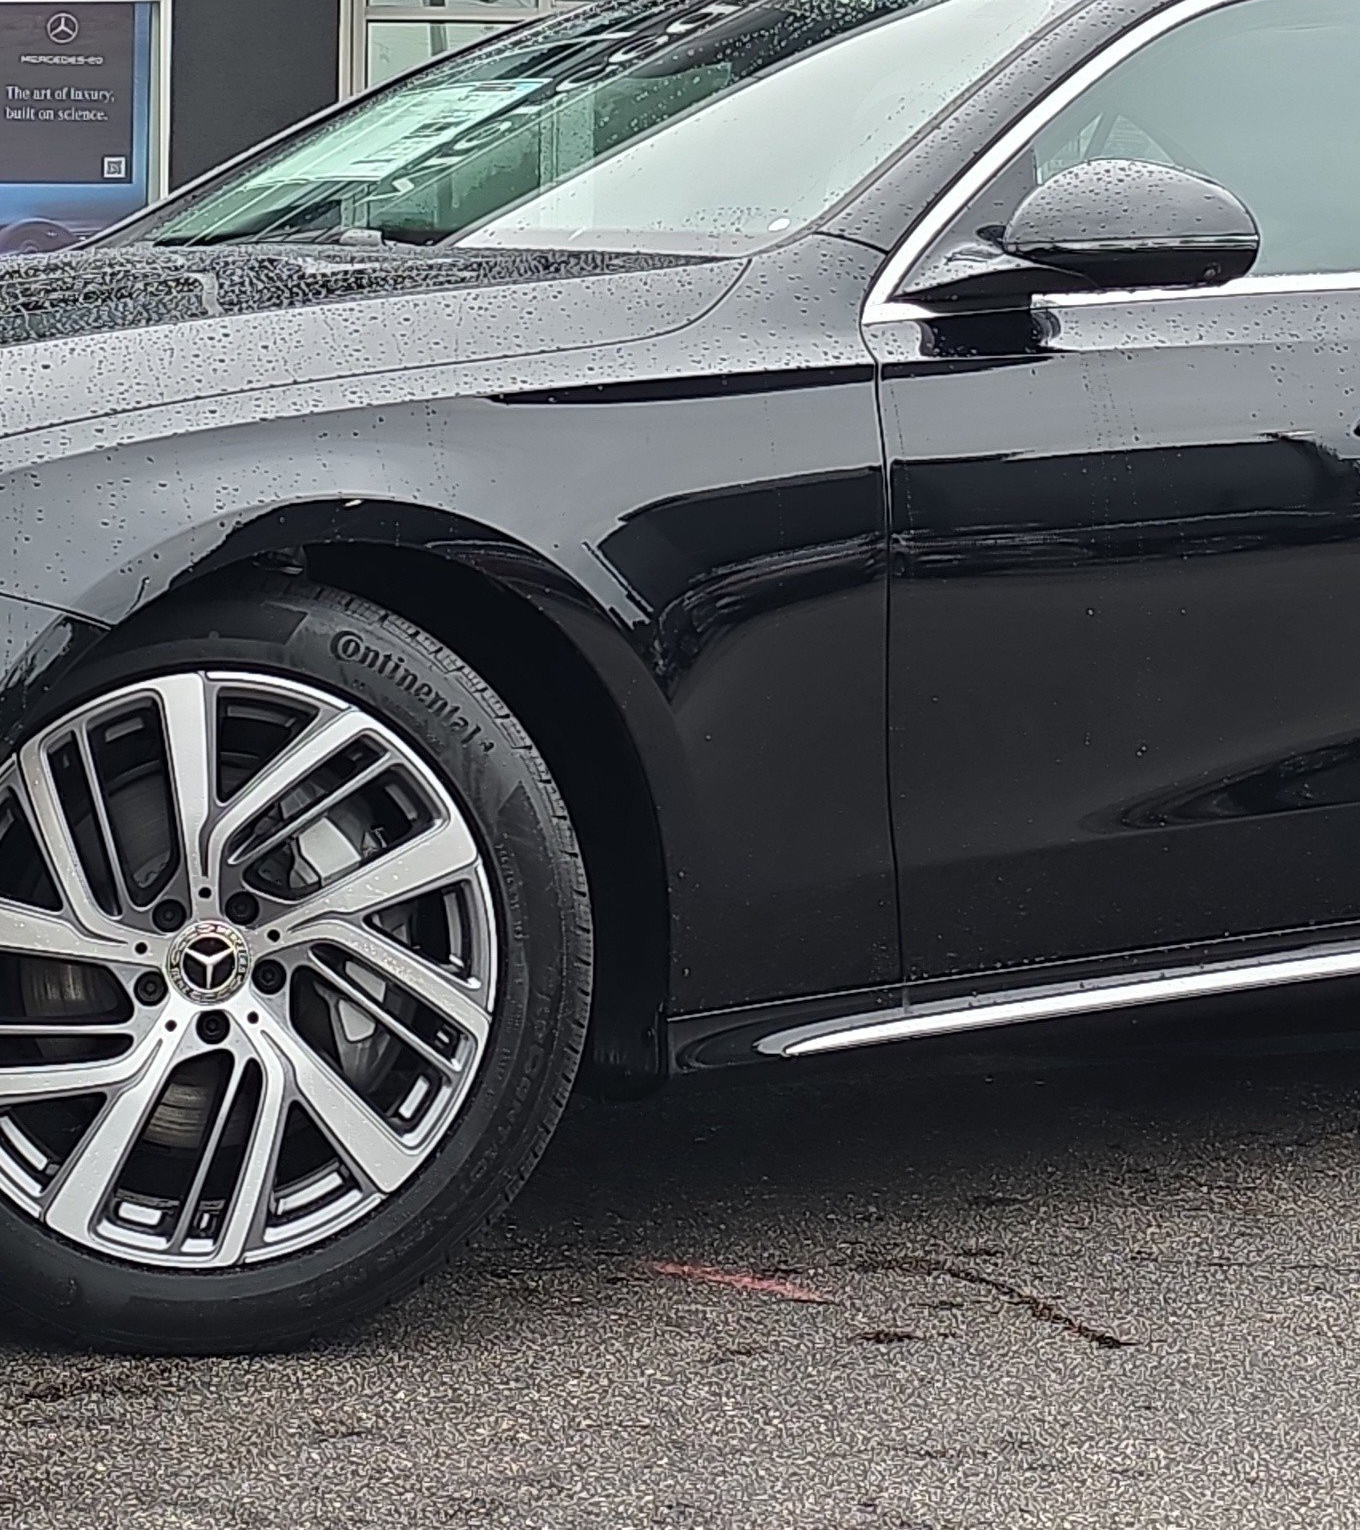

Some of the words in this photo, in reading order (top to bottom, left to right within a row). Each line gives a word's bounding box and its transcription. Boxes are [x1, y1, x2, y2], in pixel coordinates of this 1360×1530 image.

[6, 85, 30, 100] The
[33, 88, 52, 100] art
[54, 87, 68, 100] of
[70, 87, 115, 103] luxury,
[5, 106, 35, 120] built
[38, 109, 55, 120] on
[58, 107, 108, 121] science.
[329, 629, 483, 749] Continental
